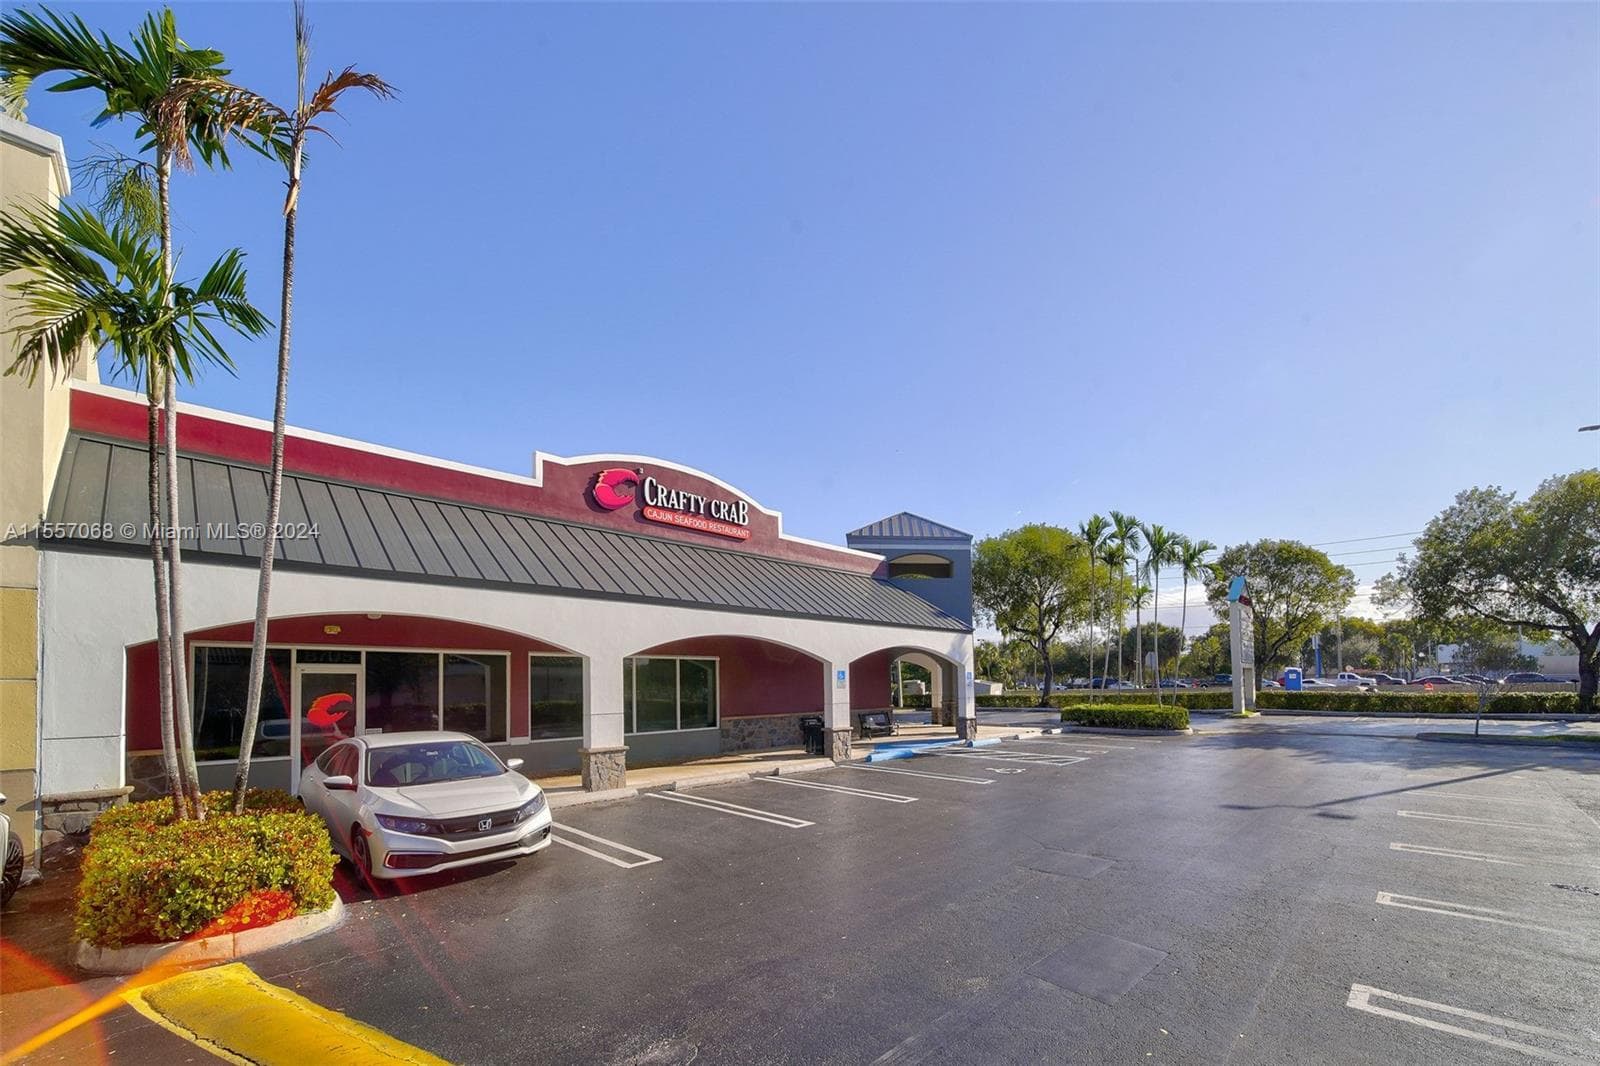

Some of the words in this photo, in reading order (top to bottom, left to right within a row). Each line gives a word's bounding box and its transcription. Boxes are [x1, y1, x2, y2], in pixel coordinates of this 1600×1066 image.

[644, 477, 707, 514] CRAFTY
[711, 500, 749, 526] CRAB
[647, 509, 673, 521] CAJUN
[675, 514, 707, 529] SEAFOOD
[708, 521, 750, 537] RESTAURANT
